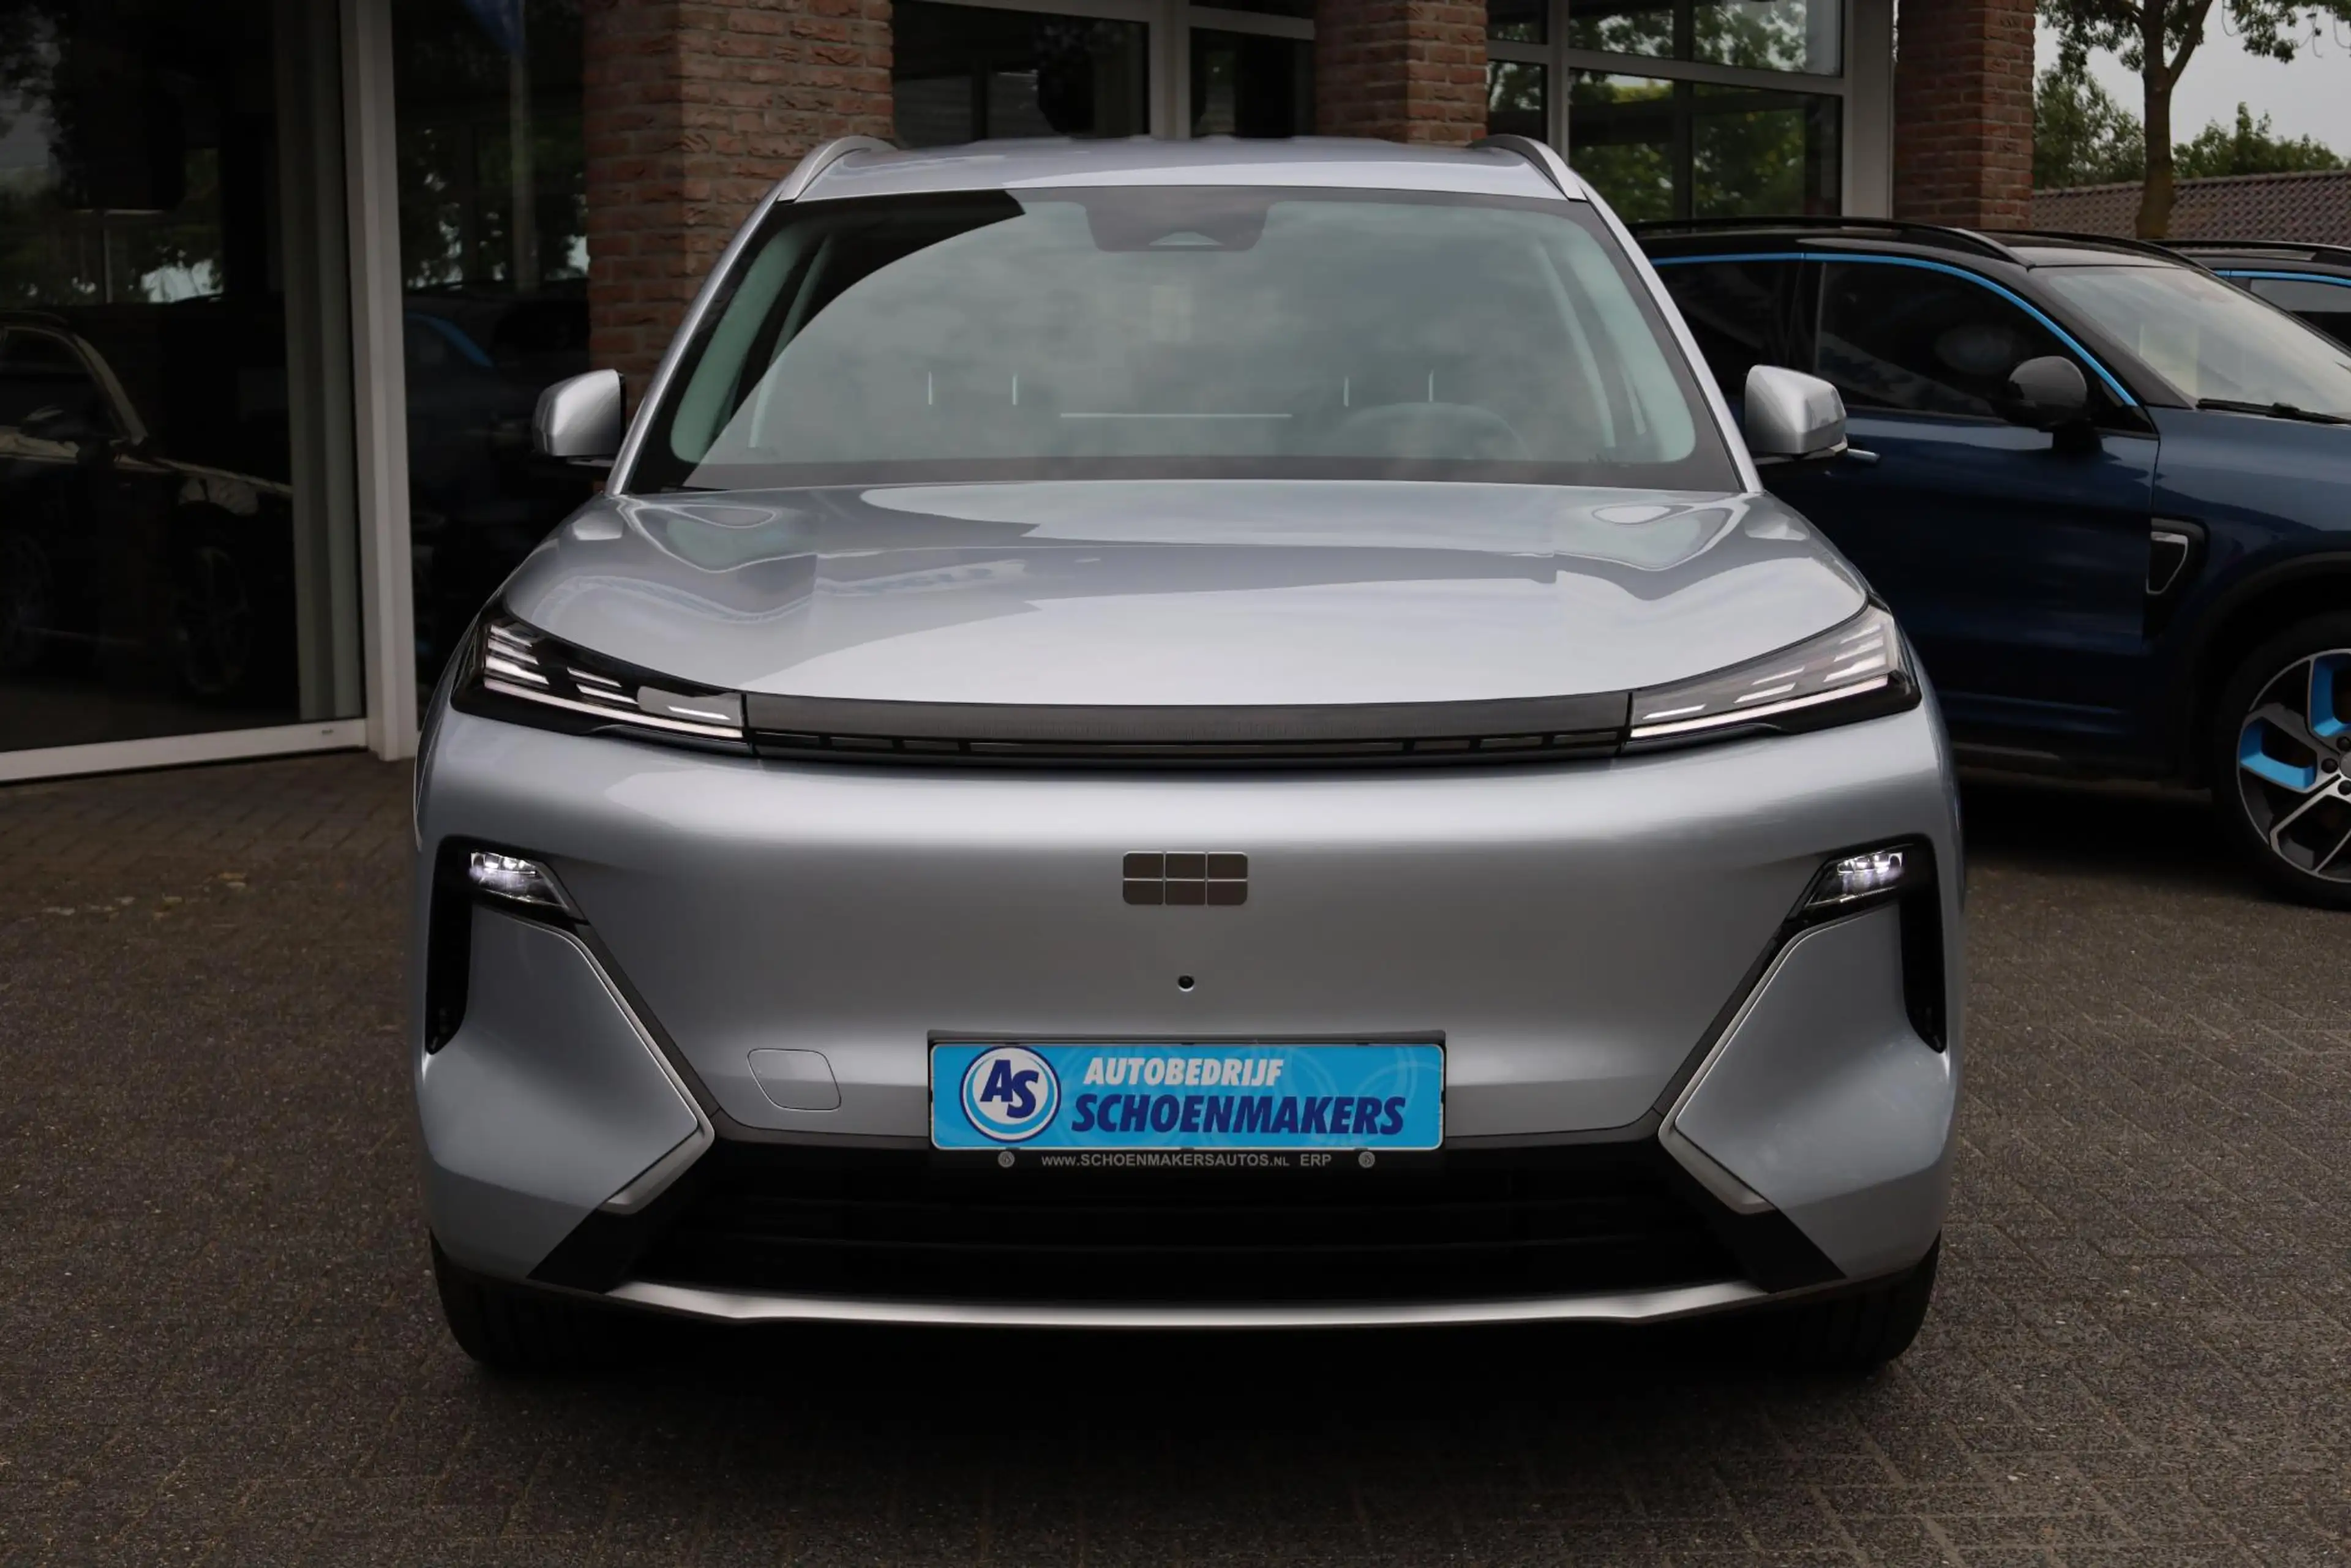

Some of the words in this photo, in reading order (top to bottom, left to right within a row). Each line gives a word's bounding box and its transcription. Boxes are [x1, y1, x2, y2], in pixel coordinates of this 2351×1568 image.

[980, 1059, 1040, 1119] AS
[1083, 1057, 1283, 1086] AUTOBEDRIJF
[1071, 1093, 1406, 1135] SCHOENMAKERS
[1300, 1153, 1332, 1166] ERP
